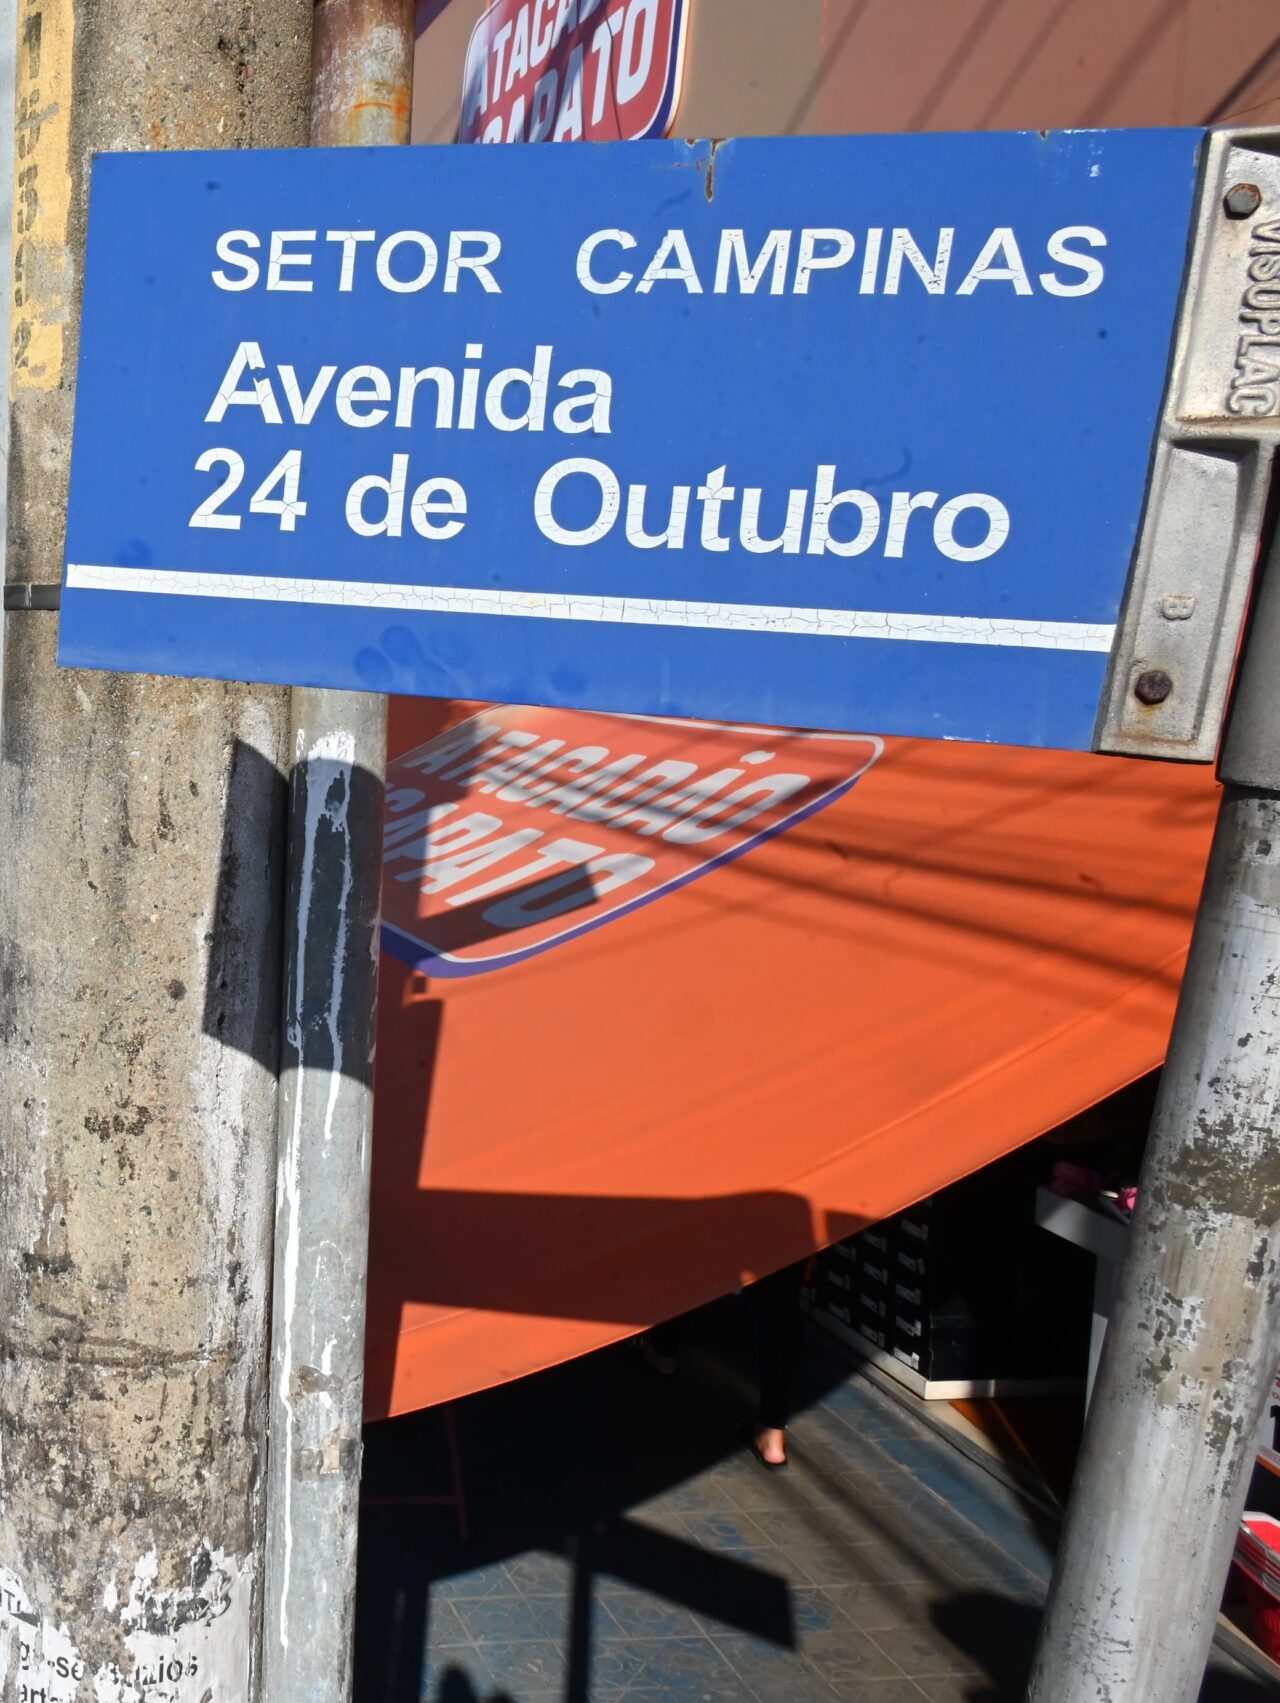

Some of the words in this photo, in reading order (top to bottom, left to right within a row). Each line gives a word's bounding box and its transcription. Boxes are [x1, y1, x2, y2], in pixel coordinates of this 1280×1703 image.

[211, 229, 502, 294] SETOR
[576, 225, 1108, 296] CAMPINAS
[203, 341, 613, 434] Avenida
[187, 447, 308, 532] 24
[345, 453, 468, 541] de
[533, 458, 1011, 562] Outubro
[403, 724, 811, 845] ATACADÃO
